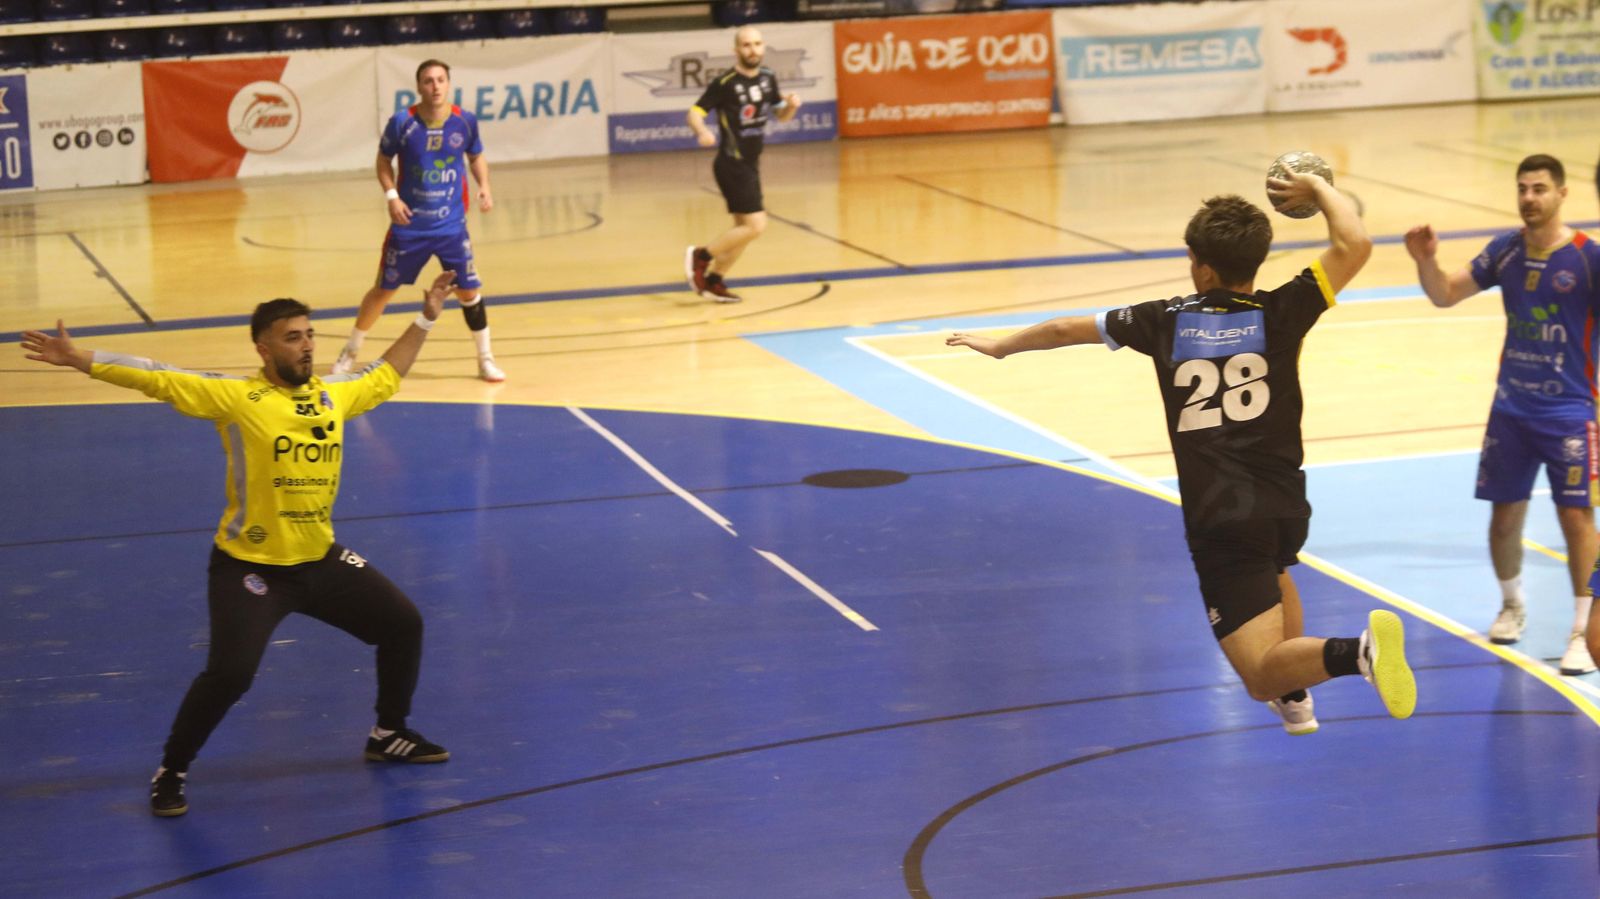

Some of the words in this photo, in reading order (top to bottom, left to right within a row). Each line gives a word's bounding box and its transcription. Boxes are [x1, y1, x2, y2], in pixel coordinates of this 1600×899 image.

[842, 31, 917, 73] GUÍA
[919, 36, 972, 69] DE
[977, 32, 1048, 66] OCIO
[1085, 37, 1257, 73] REMESA
[426, 136, 443, 151] 13
[1179, 325, 1258, 340] VITALDENT
[1174, 353, 1271, 432] 28
[274, 435, 341, 463] Proin
